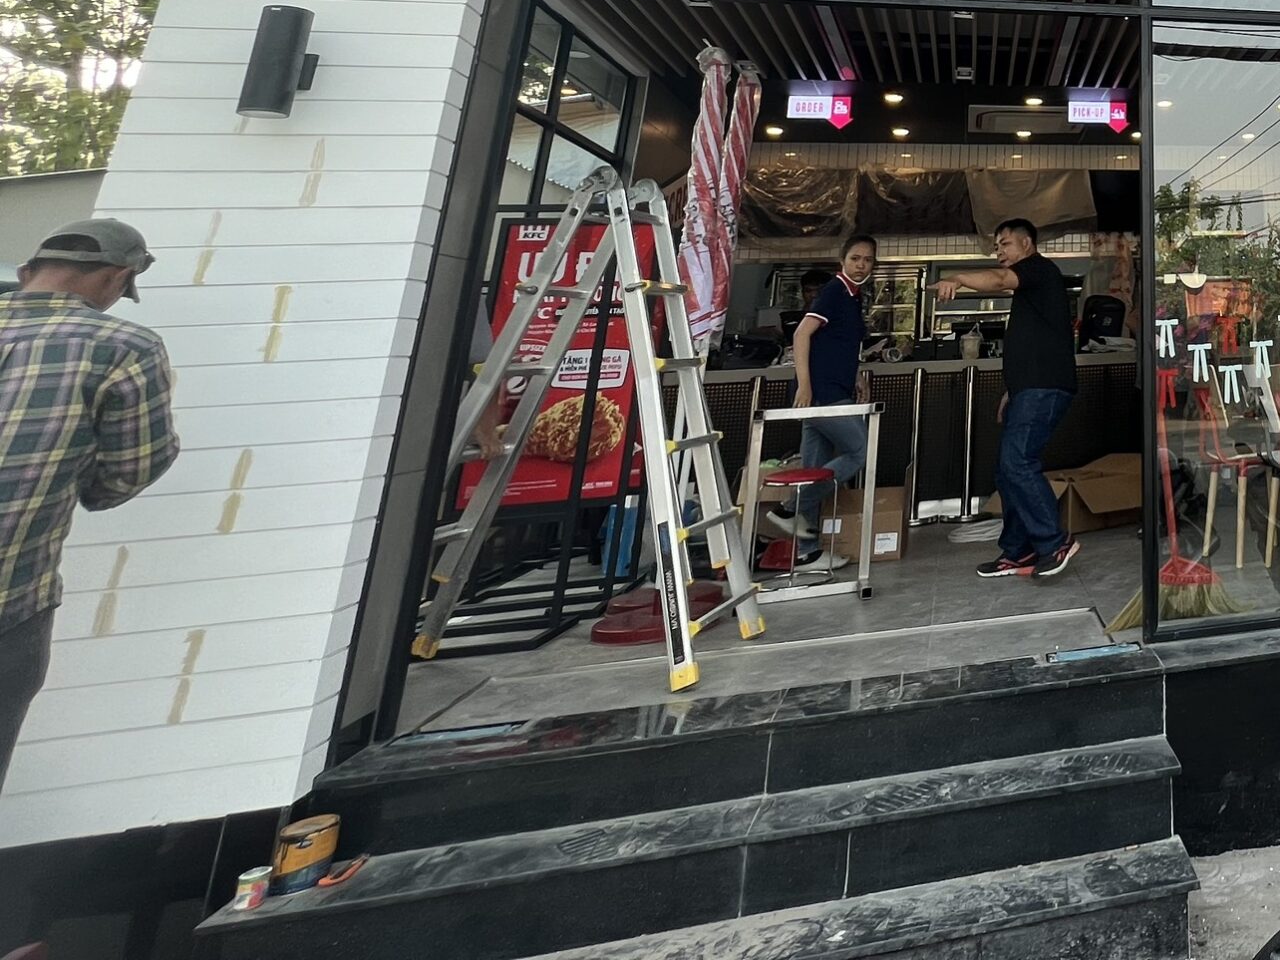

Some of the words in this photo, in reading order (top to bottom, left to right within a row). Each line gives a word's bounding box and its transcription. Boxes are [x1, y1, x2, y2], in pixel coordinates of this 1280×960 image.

[795, 101, 825, 113] ORDER
[1072, 106, 1105, 118] PICK-UP
[522, 231, 546, 239] KFC
